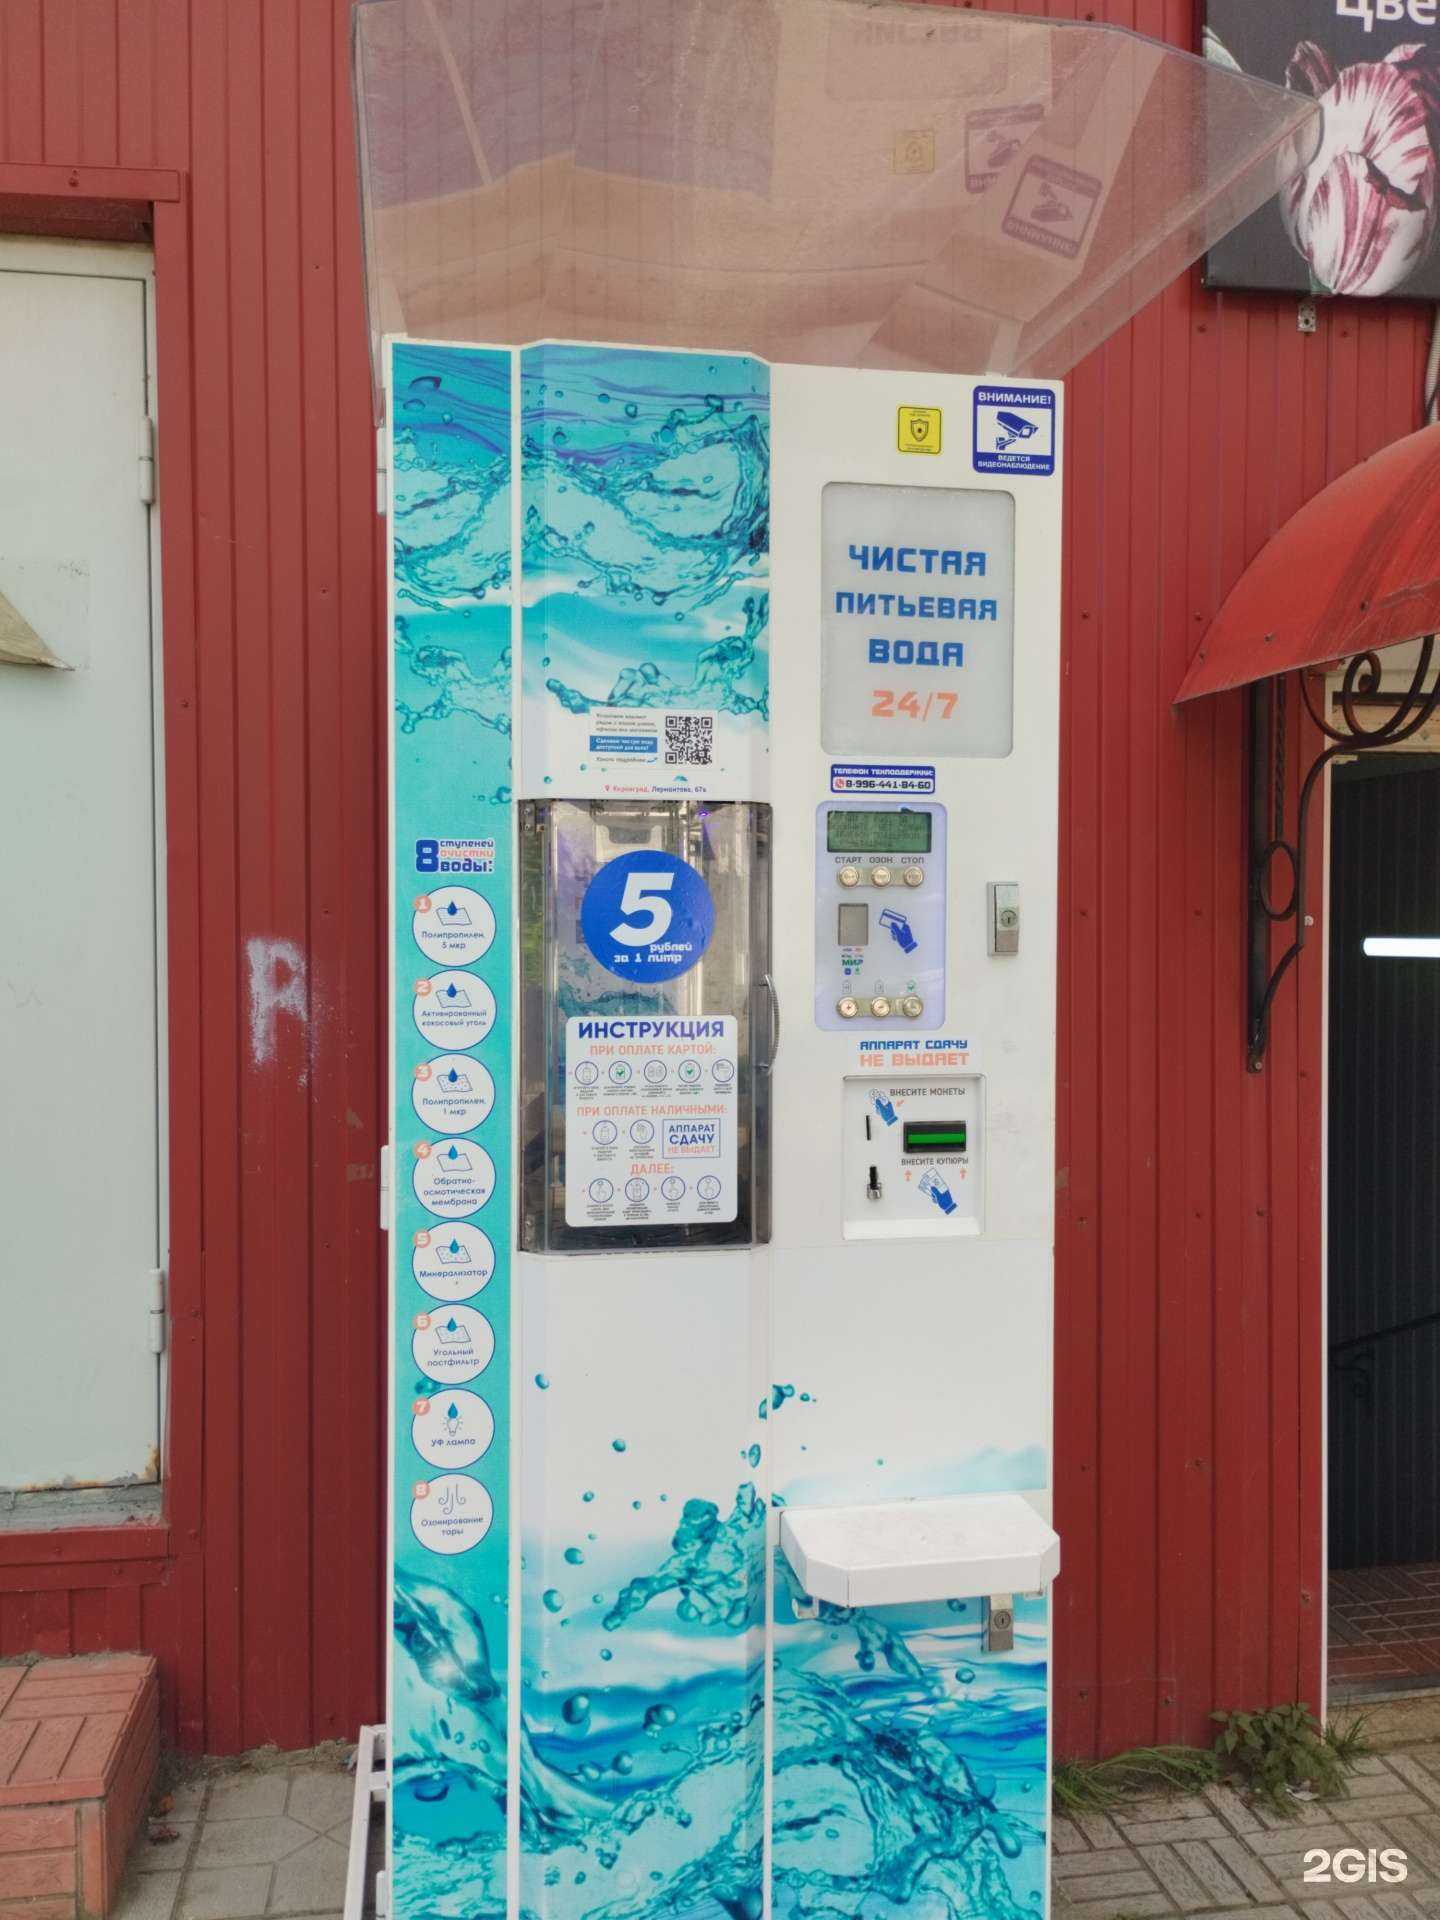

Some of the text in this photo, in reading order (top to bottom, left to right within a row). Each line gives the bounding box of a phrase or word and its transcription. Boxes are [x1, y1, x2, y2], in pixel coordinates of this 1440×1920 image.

[979, 392, 1051, 404] ВНИМАНИЕ!
[978, 461, 1050, 470] ВИДЕОНАБЛЮДЕНИЕ
[849, 544, 986, 576] ЧИСТАЯ
[835, 592, 997, 621] ПИТЬЕВАЯ
[868, 638, 963, 667] ВОДА
[871, 689, 959, 721] 24/7
[846, 780, 931, 789] 8-996-441-84-60
[440, 840, 493, 848] ступеней
[416, 840, 439, 872] 8
[440, 849, 493, 858] очистки
[440, 858, 492, 872] воды:
[609, 872, 674, 947] 5
[649, 942, 692, 953] рублей
[634, 953, 642, 962] 1
[648, 953, 682, 964] литр
[578, 1021, 724, 1040] ИНСТРУКЦИЯ
[590, 1042, 716, 1055] ПРИ ОПЛАТЕ КАРТОЙ:
[860, 1040, 968, 1050] АППАРАТ СДАЧУ
[860, 1053, 969, 1067] НЕ ВЫДАЕТ
[889, 1088, 965, 1097] ВНЕСИТЕ МОНЕТЫ
[577, 1104, 727, 1116] ПРИ ОПЛАТЕ НАЛИЧНЫМИ:
[669, 1124, 716, 1133] АППАРАТ
[669, 1134, 714, 1145] СДАЧУ
[936, 1157, 969, 1165] КУПЮРЫ
[630, 1163, 674, 1176] ДАЛЕЕ:
[424, 1188, 485, 1196] осмотическая
[432, 1198, 477, 1207] мембрана
[420, 1269, 487, 1278] Минерализатор
